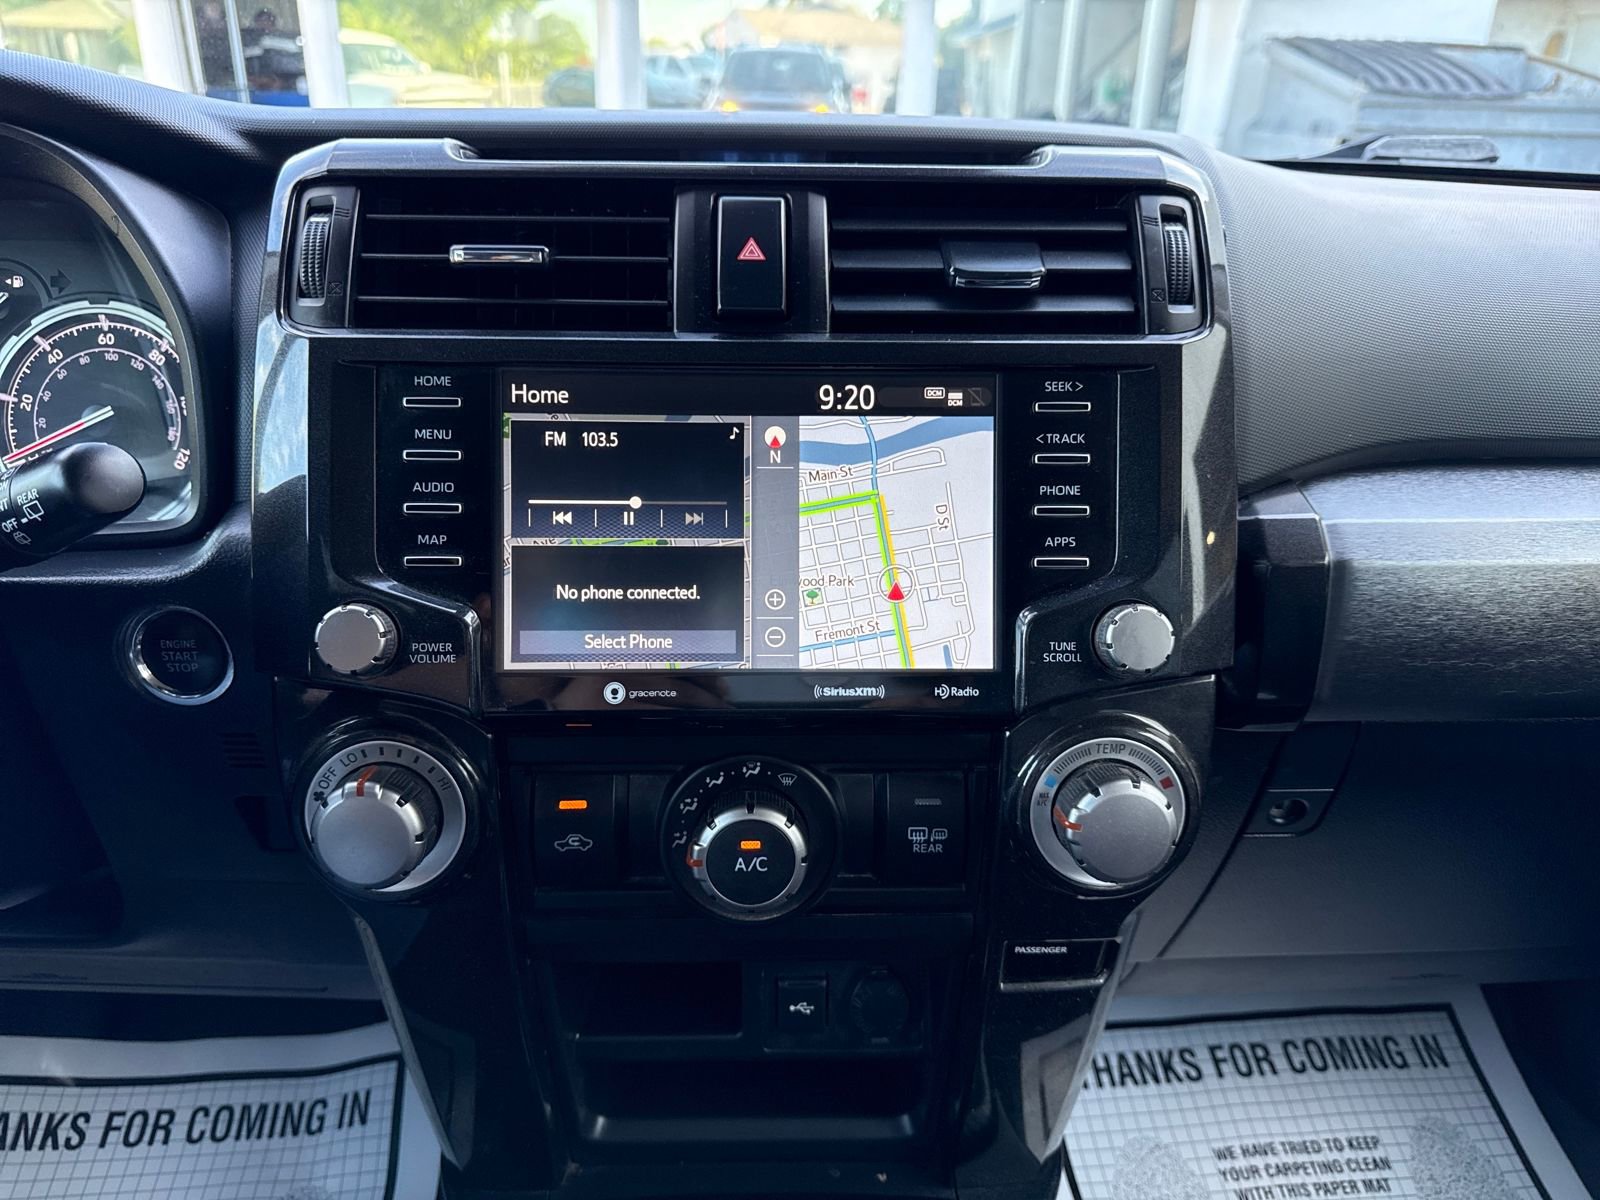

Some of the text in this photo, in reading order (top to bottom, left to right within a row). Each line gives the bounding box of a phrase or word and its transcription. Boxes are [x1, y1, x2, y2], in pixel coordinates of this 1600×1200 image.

[98, 333, 115, 345] 60
[47, 349, 64, 365] 40
[79, 354, 91, 365] 80
[104, 352, 119, 362] 100
[148, 349, 166, 366] 80
[130, 358, 145, 371] 120
[57, 368, 68, 380] 60
[414, 375, 452, 387] HOME
[42, 390, 52, 402] 40
[511, 383, 569, 404] Home
[819, 384, 876, 411] 9:20
[927, 389, 943, 397] DCM
[20, 394, 33, 411] 20
[947, 399, 963, 407] DCM
[38, 417, 47, 429] 20
[414, 429, 452, 440] MENU
[544, 431, 619, 447] FM 103.5
[174, 448, 190, 470] 120
[769, 450, 782, 464] N
[808, 466, 854, 483] Main St
[412, 481, 455, 493] AUDIO
[1039, 485, 1081, 496] PHONE
[17, 488, 39, 506] REAR
[936, 504, 949, 531] D St
[1, 517, 18, 533] OFF
[417, 534, 447, 545] MAP
[1044, 536, 1076, 547] APPS
[828, 575, 855, 587] Park
[556, 584, 701, 602] No phone connected.
[815, 620, 881, 642] Fremont St
[160, 639, 198, 649] ENGINE
[411, 642, 453, 653] POWER
[584, 634, 673, 649] Select Phone
[1049, 641, 1077, 651] TUNE
[161, 651, 199, 661] START
[409, 653, 457, 664] VOLUME
[1043, 653, 1082, 663] SCROLL
[167, 663, 199, 672] STOP
[628, 688, 677, 699] gracenote
[951, 686, 980, 697] Radio
[1095, 743, 1127, 754] TEMP
[339, 752, 358, 767] LO
[318, 766, 338, 790] OFF
[438, 777, 451, 791] HI
[912, 843, 944, 853] REAR
[734, 857, 768, 873] A/C
[1014, 945, 1068, 954] PASSENGER
[1083, 1033, 1450, 1089] HANKS FOR COMING IN
[99, 1108, 176, 1149] FOR
[186, 1098, 327, 1144] COMING
[338, 1089, 371, 1129] IN
[1212, 1135, 1381, 1161] WE HAVE TRIED TO KEEP
[1218, 1156, 1393, 1182] YOUR CARPETING CLEAN
[1234, 1177, 1393, 1200] WITH THIS PAPER MAT
